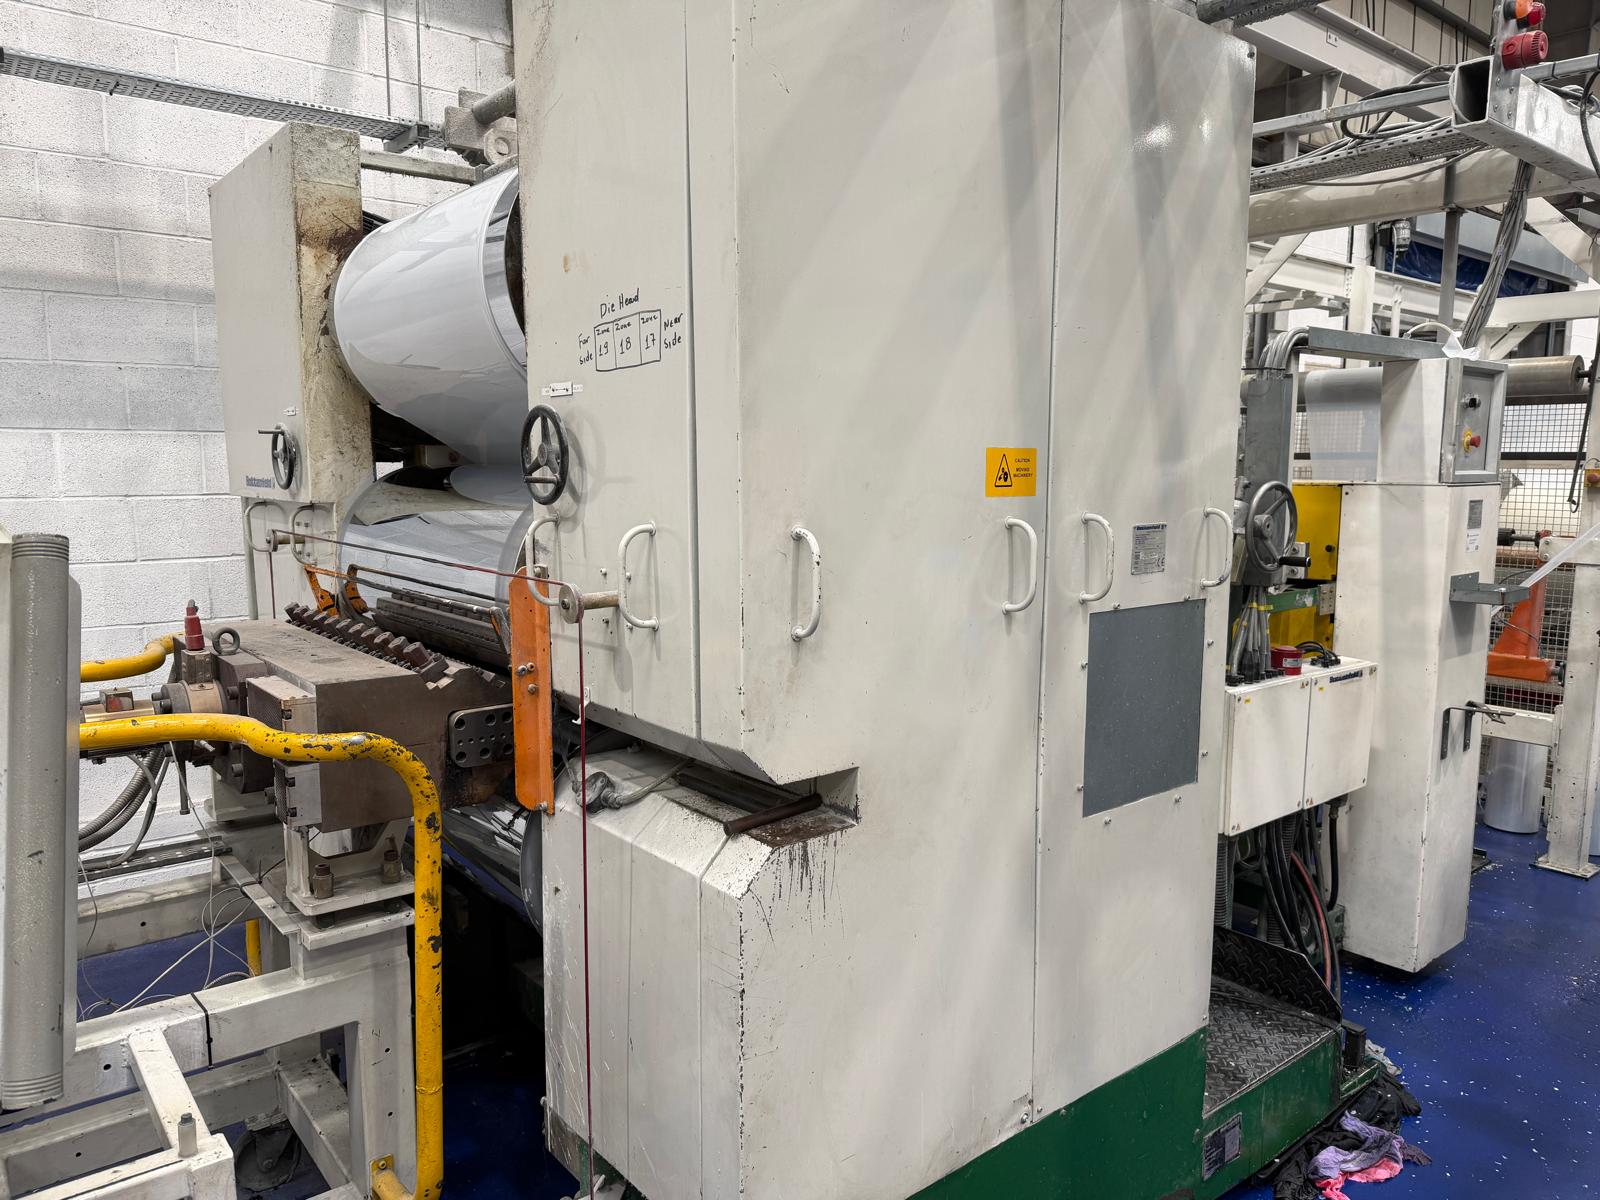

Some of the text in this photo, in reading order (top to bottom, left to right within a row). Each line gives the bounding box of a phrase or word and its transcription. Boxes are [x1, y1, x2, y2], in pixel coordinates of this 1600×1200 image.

[600, 287, 640, 319] Die Head
[578, 333, 591, 349] Far
[598, 341, 609, 357] 19
[620, 336, 632, 354] 18
[645, 333, 656, 350] 17
